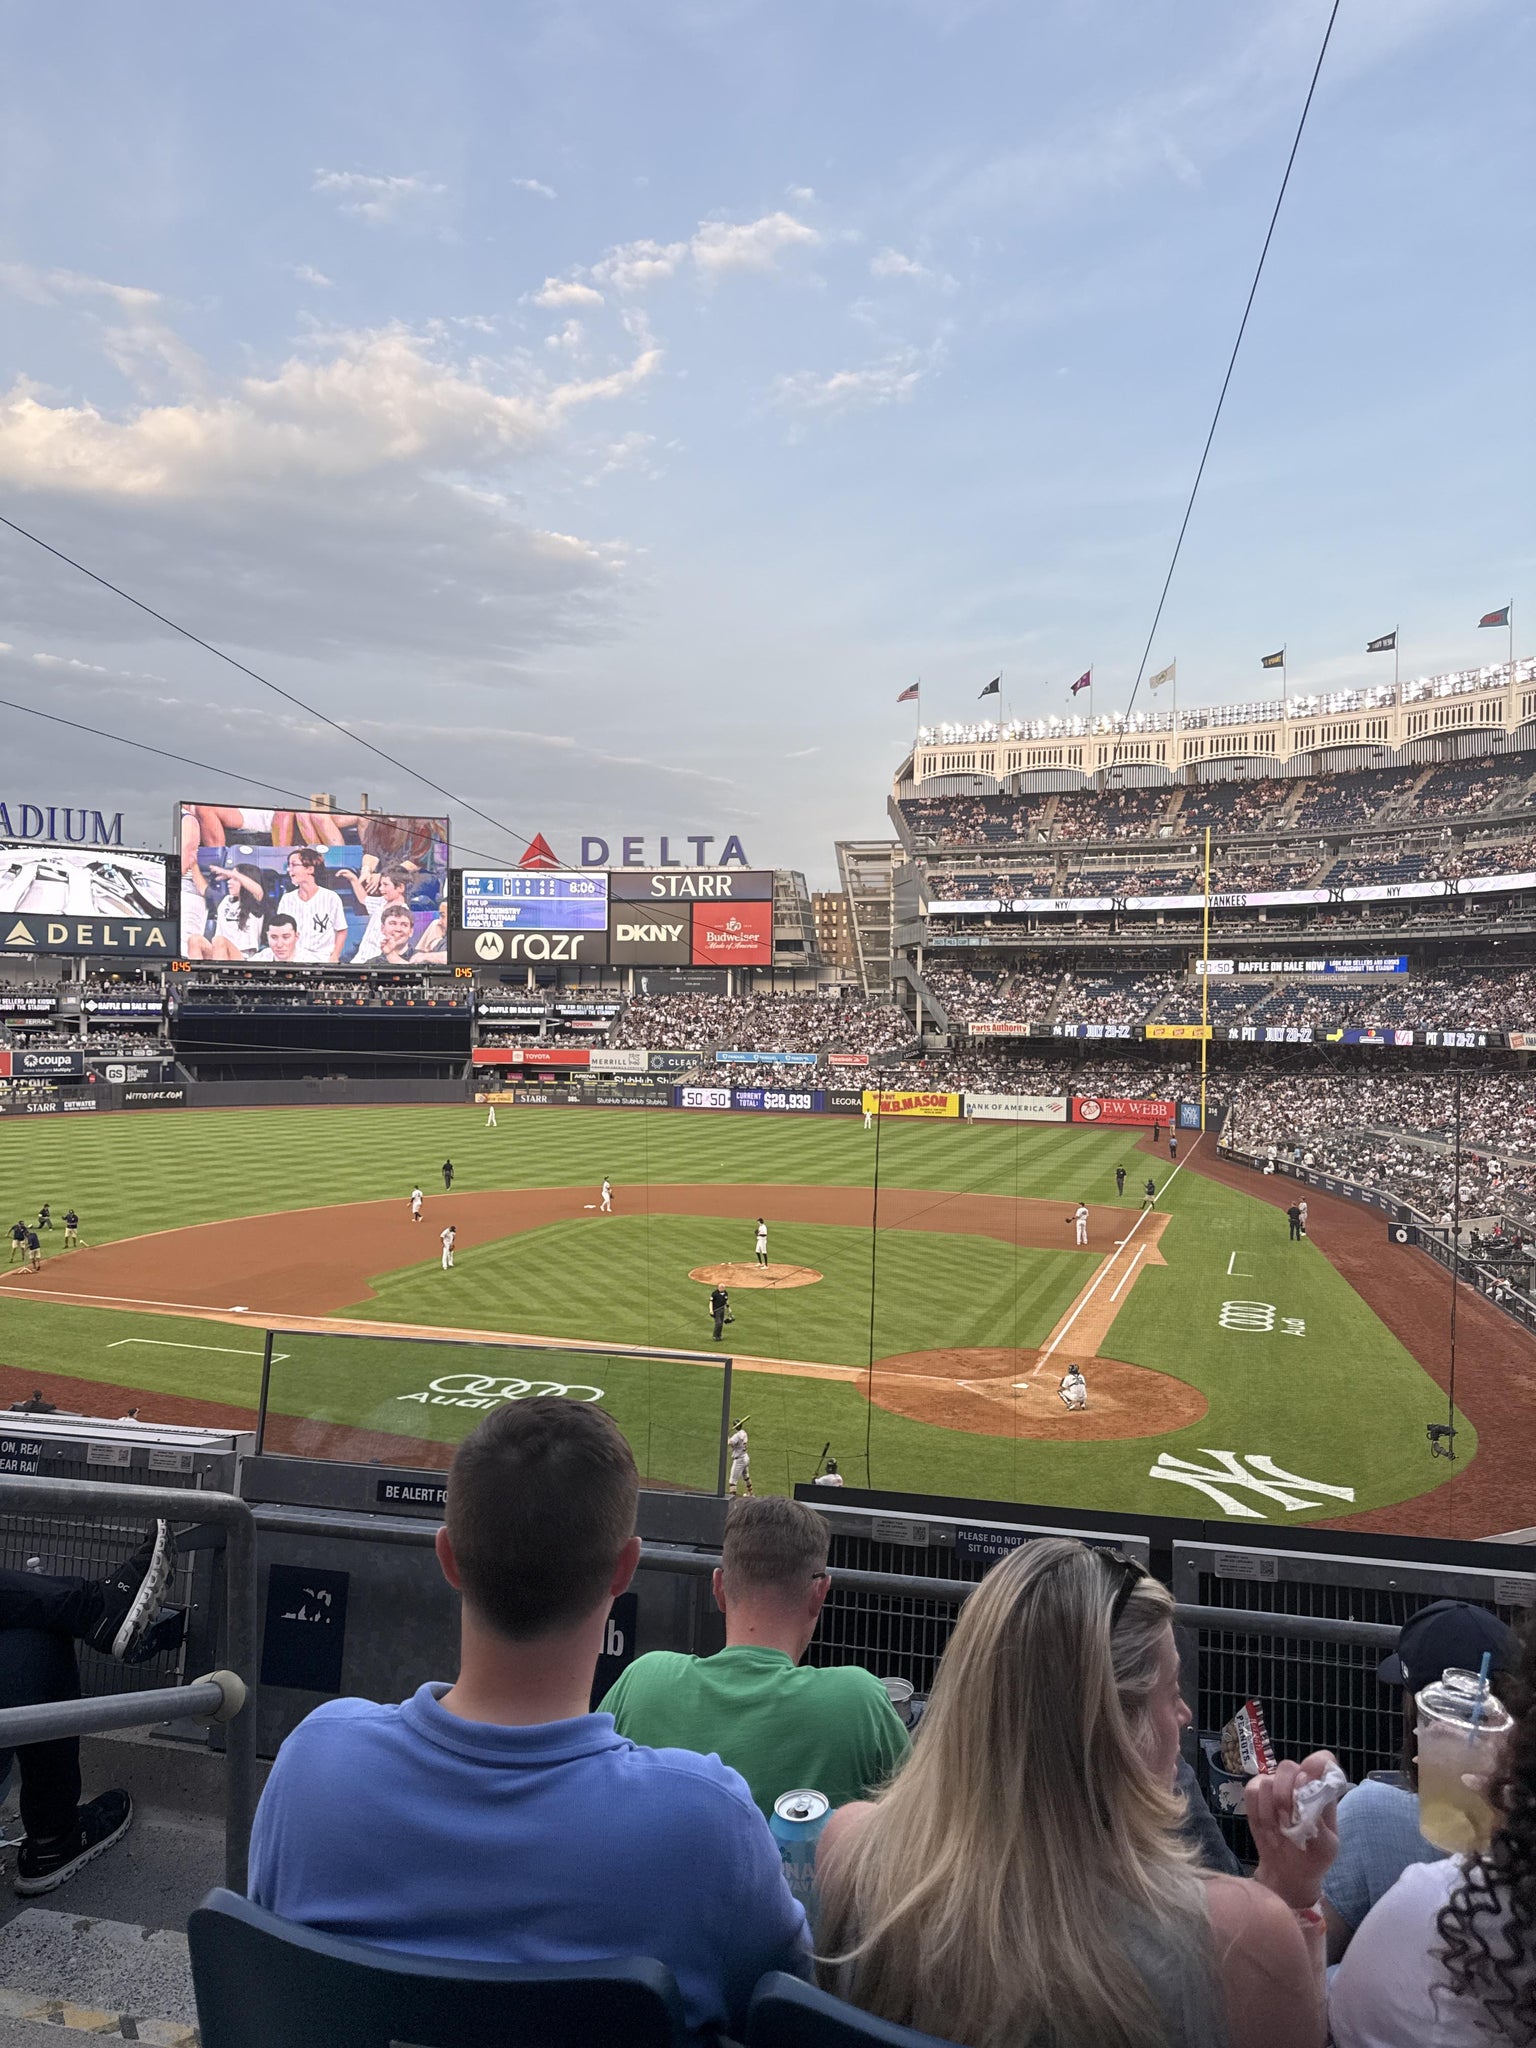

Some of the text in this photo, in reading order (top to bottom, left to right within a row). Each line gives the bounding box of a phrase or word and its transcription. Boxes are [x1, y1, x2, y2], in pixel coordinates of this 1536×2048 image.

[581, 835, 748, 867] DELTA
[569, 882, 595, 893] 8:06
[651, 875, 732, 897] STARR
[1386, 887, 1401, 896] NYY
[1055, 901, 1068, 909] NYY
[1208, 895, 1247, 907] YANKEES
[48, 923, 167, 948] DELTA
[616, 924, 684, 942] DKNY
[706, 932, 760, 942] Budweiser
[511, 934, 584, 960] razr
[1217, 963, 1230, 972] 50
[1238, 961, 1269, 972] RAFFLE
[1283, 961, 1304, 971] SALE
[455, 968, 472, 978] 0:45
[992, 1024, 1026, 1032] Authority
[1065, 1025, 1078, 1037] PIT
[1242, 1027, 1257, 1040] PIT
[1426, 1032, 1438, 1045] PIT
[39, 1056, 72, 1067] coupa
[109, 1070, 122, 1078] GS
[126, 1091, 183, 1100] NITTOTIRE.COM
[687, 1092, 726, 1106] 50 50
[736, 1092, 762, 1100] CURRENT
[764, 1092, 811, 1110] $28,939
[27, 1103, 56, 1112] STARR
[64, 1100, 96, 1108] CUTWATER
[832, 1098, 862, 1106] LEGORA
[1004, 1104, 1044, 1112] AMERICA
[1103, 1102, 1167, 1115] F.W. WEBB
[1280, 1317, 1306, 1336] Audi
[397, 1392, 500, 1409] Audi
[1, 1442, 18, 1455] ON,
[1149, 1448, 1355, 1518] NY
[386, 1485, 449, 1503] BE ALERT FO
[958, 1531, 988, 1542] PLEASE
[990, 1533, 1002, 1543] DO
[1004, 1536, 1022, 1545] NOT
[968, 1543, 1009, 1555] SIT ON OR
[1236, 1715, 1250, 1762] PEANUTS
